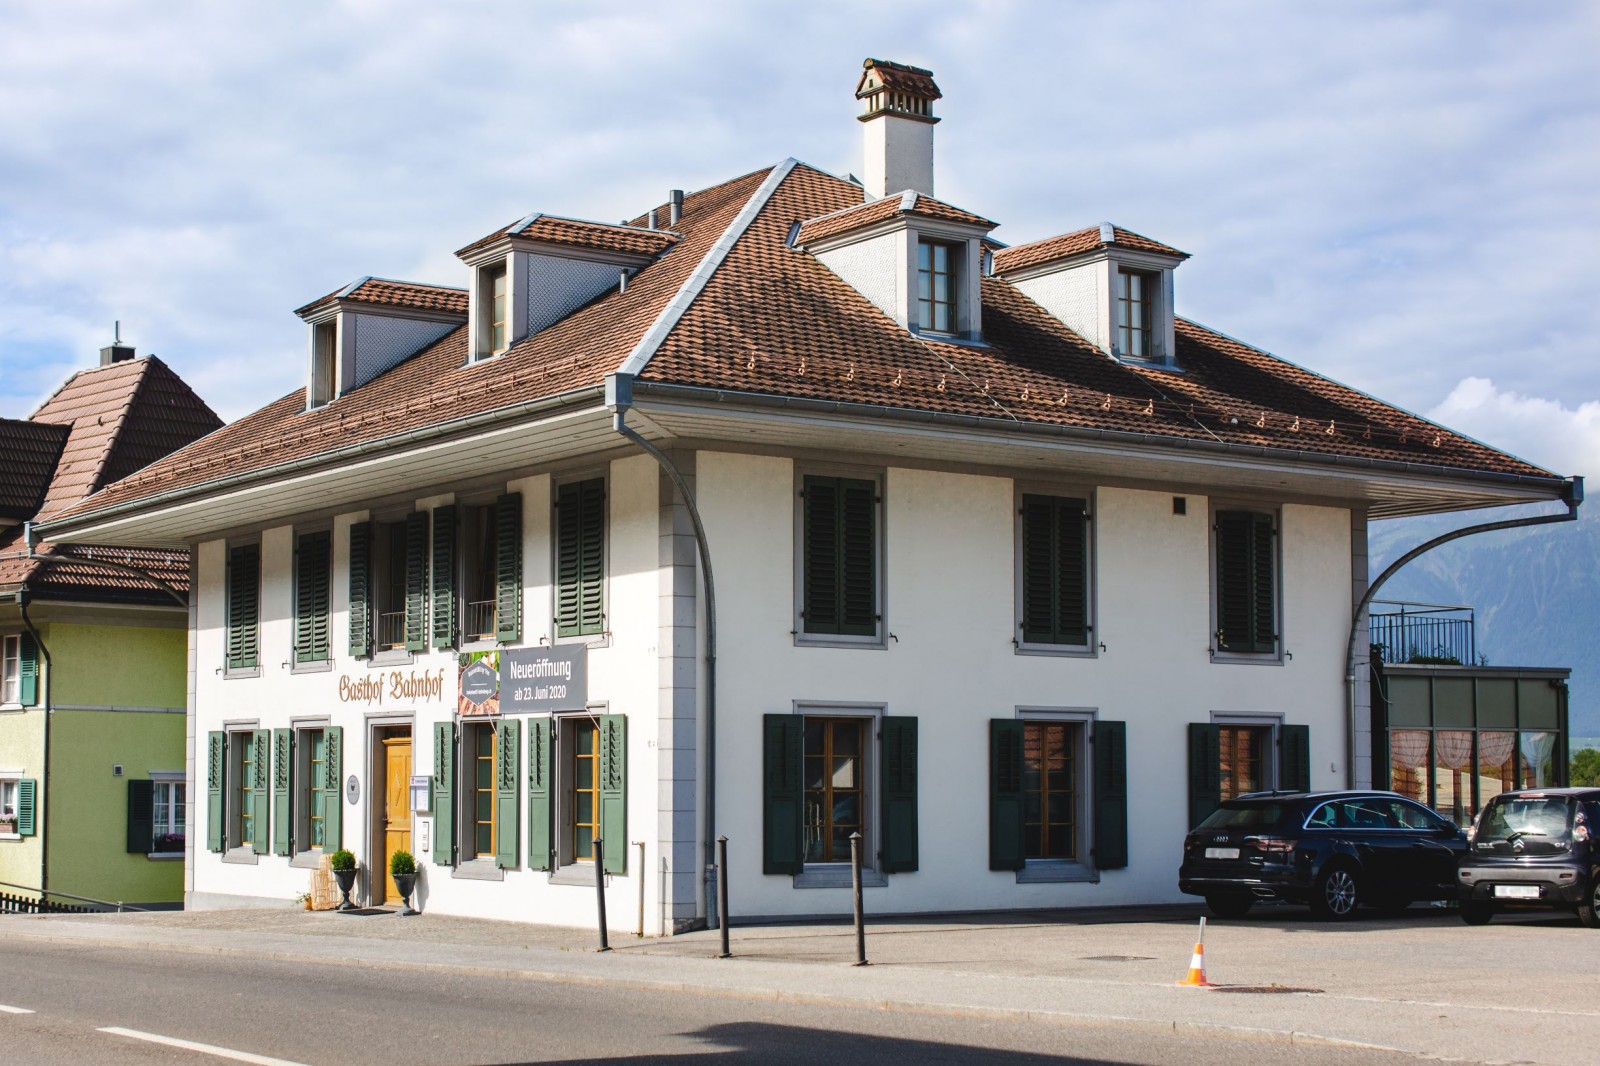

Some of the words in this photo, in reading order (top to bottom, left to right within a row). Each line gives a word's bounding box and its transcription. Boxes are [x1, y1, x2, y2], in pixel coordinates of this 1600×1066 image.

[510, 659, 571, 680] Neueröffnung
[339, 673, 385, 706] Gasthof
[390, 668, 445, 704] Bahnhof
[514, 687, 522, 700] ab
[523, 687, 533, 700] 23.
[534, 685, 548, 700] Juni
[549, 685, 566, 699] 2020
